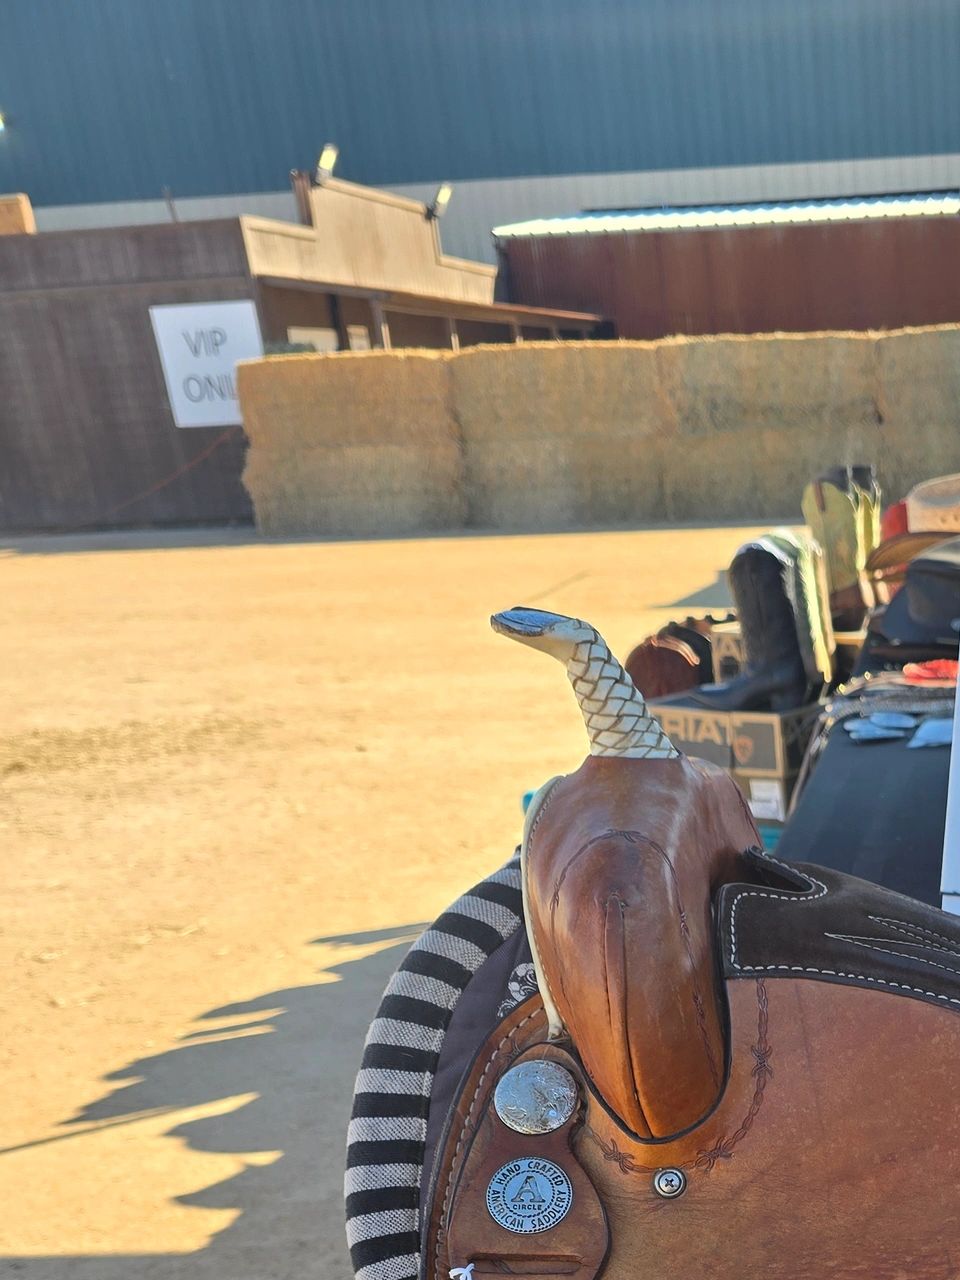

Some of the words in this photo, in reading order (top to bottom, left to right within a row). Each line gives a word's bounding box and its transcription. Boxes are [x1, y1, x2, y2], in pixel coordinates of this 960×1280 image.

[182, 327, 228, 358] VIP
[495, 1163, 521, 1186] HAND
[527, 1160, 564, 1187] CRAFTED
[510, 1175, 546, 1203] A
[491, 1189, 524, 1229] AMERICAN
[531, 1190, 567, 1229] SADDLERY
